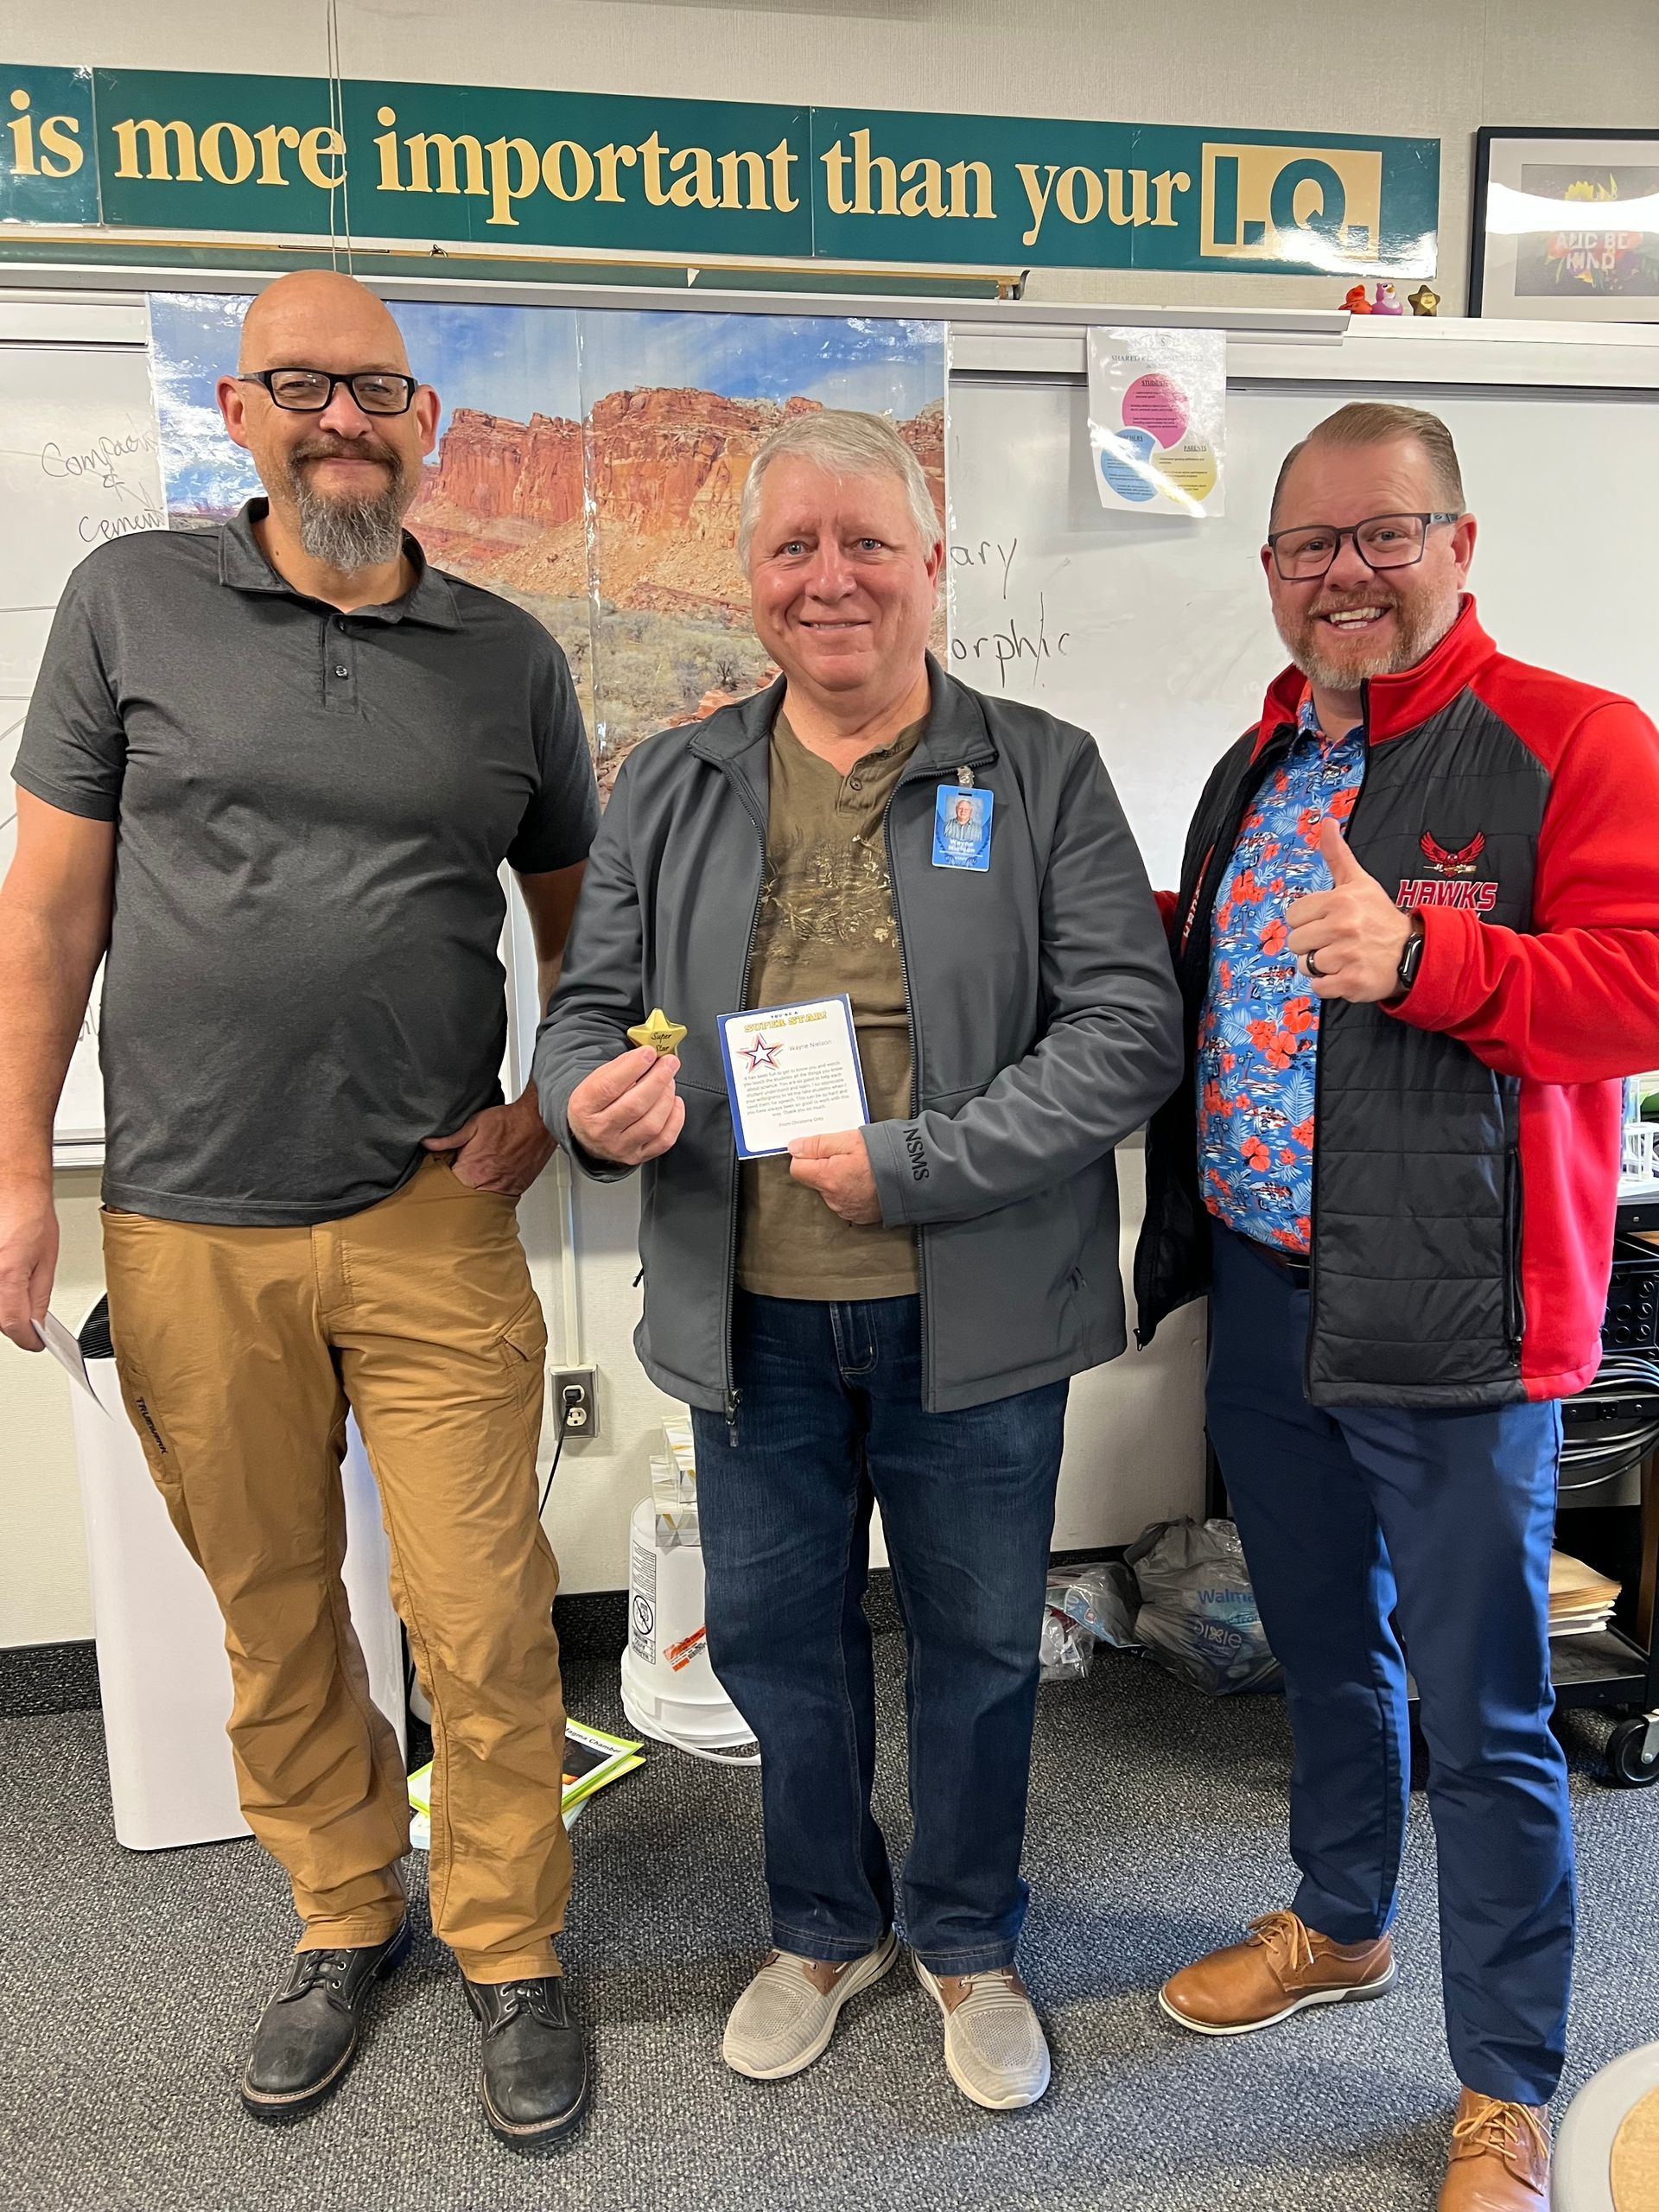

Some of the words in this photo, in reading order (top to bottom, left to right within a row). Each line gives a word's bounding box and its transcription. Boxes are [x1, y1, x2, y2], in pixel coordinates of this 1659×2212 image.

[6, 89, 84, 178] is
[112, 118, 346, 188] more
[373, 106, 799, 226] important
[820, 128, 997, 218] than
[1015, 164, 1191, 246] your
[1213, 156, 1369, 251] I.Q.
[1605, 232, 1629, 250] BE
[1566, 252, 1615, 270] KIND
[950, 537, 1018, 600] ary
[1396, 880, 1499, 911] HAWKS
[744, 1019, 786, 1033] SUPER
[788, 1011, 827, 1025] STAR!
[651, 1032, 672, 1044] Super
[903, 1128, 930, 1182] NSMS
[588, 1738, 622, 1754] Chamber
